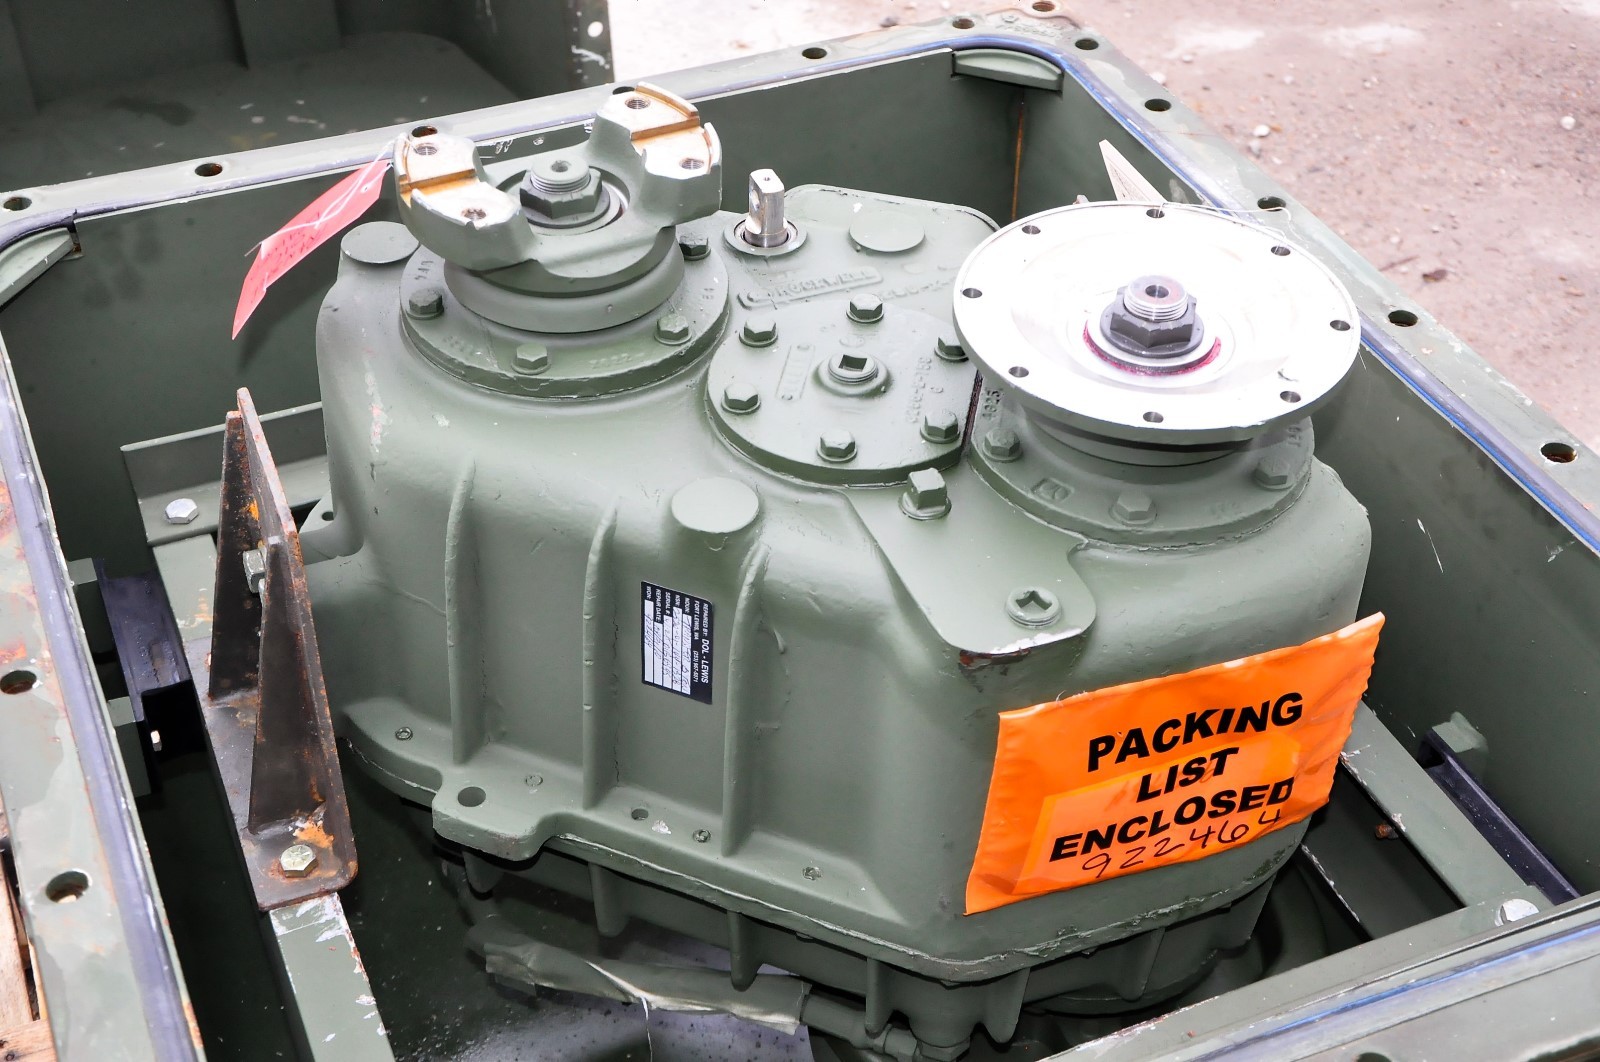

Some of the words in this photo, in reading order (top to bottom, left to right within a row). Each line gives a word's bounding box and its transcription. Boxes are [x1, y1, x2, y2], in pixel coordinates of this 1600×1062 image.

[701, 639, 710, 654] DOL
[701, 660, 709, 684] LEWIS
[1087, 692, 1303, 773] PACKING
[1135, 747, 1240, 803] LIST
[1049, 776, 1296, 863] ENCLOSED
[1082, 809, 1283, 879] 922464
